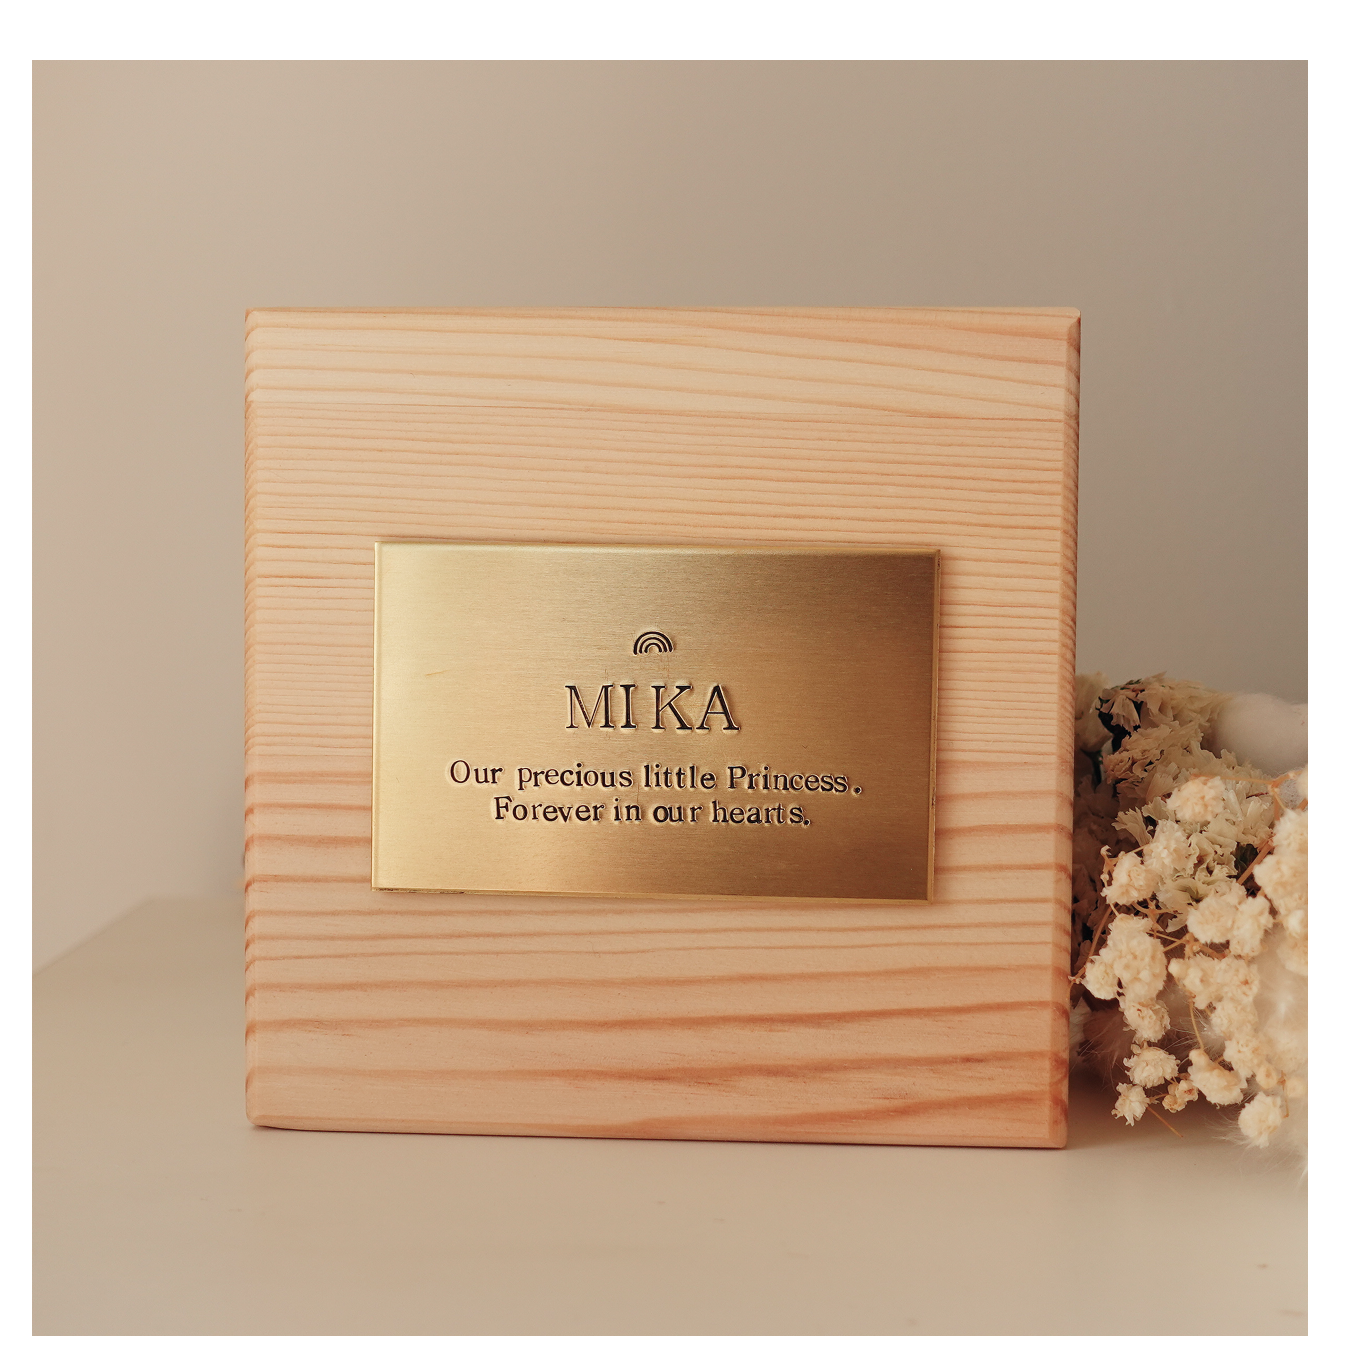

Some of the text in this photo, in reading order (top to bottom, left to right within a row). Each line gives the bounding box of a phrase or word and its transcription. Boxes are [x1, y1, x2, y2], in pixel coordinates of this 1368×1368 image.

[564, 683, 740, 732] MIKA
[449, 759, 863, 795] Our precious little Princess.
[493, 796, 811, 827] Forever in our hearts.
